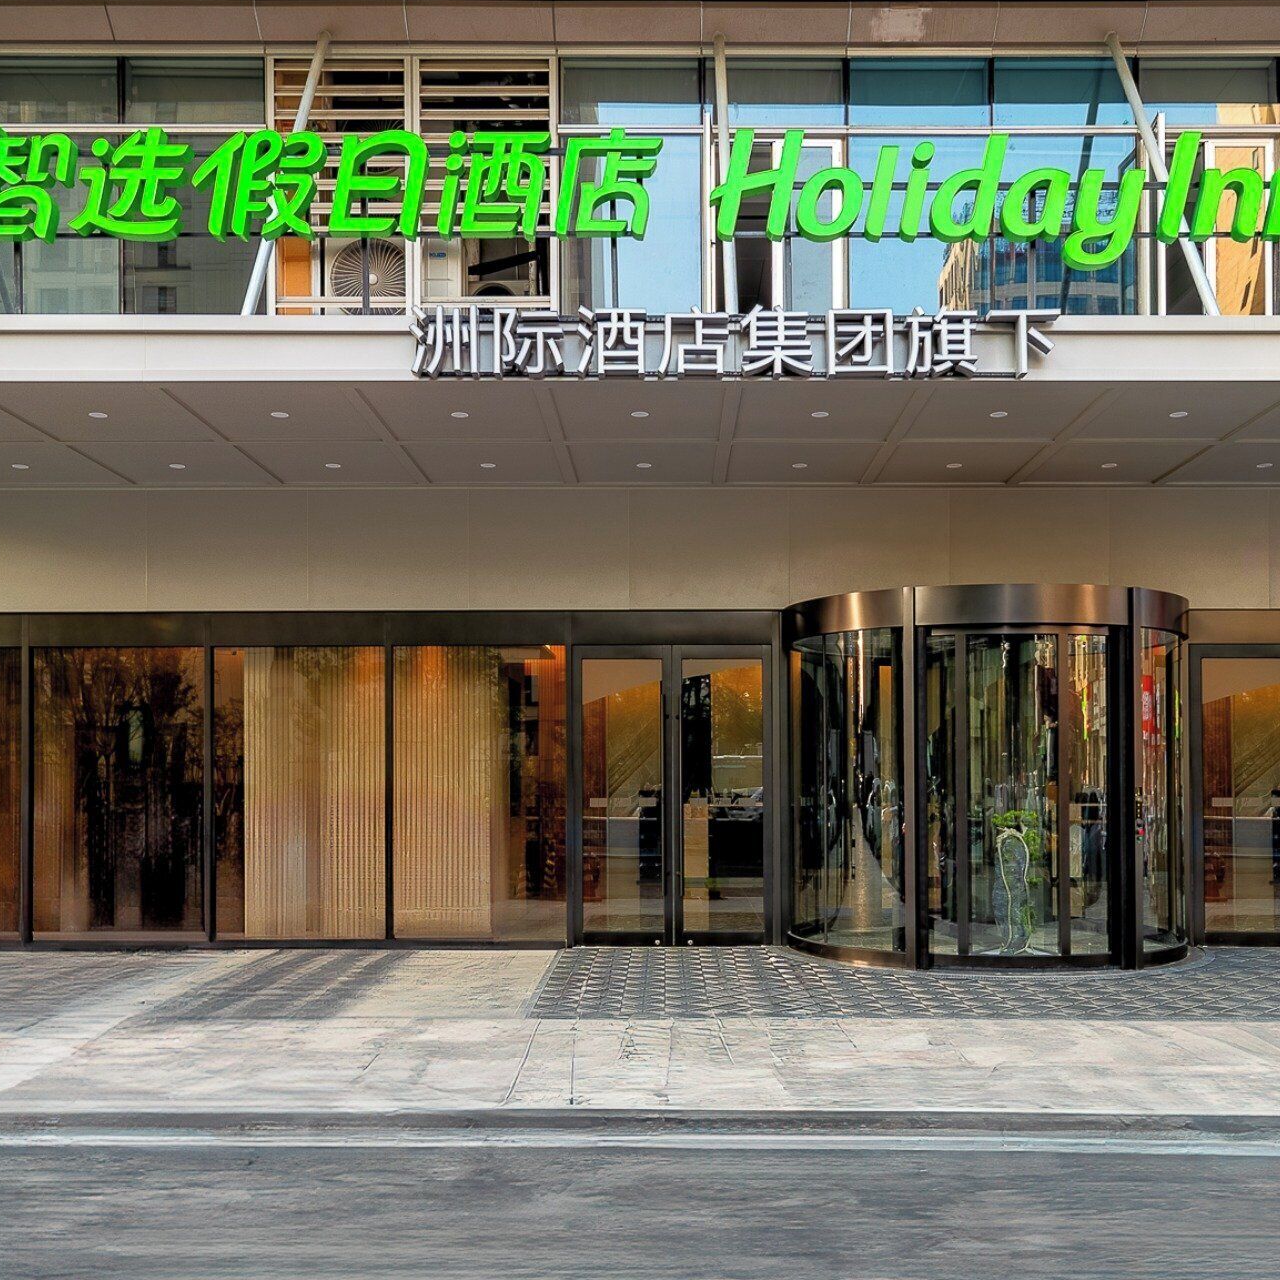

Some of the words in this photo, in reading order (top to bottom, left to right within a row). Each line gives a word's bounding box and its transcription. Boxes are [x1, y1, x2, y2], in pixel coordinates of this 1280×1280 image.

[409, 304, 1061, 379] 洲际酒店集团旗下
